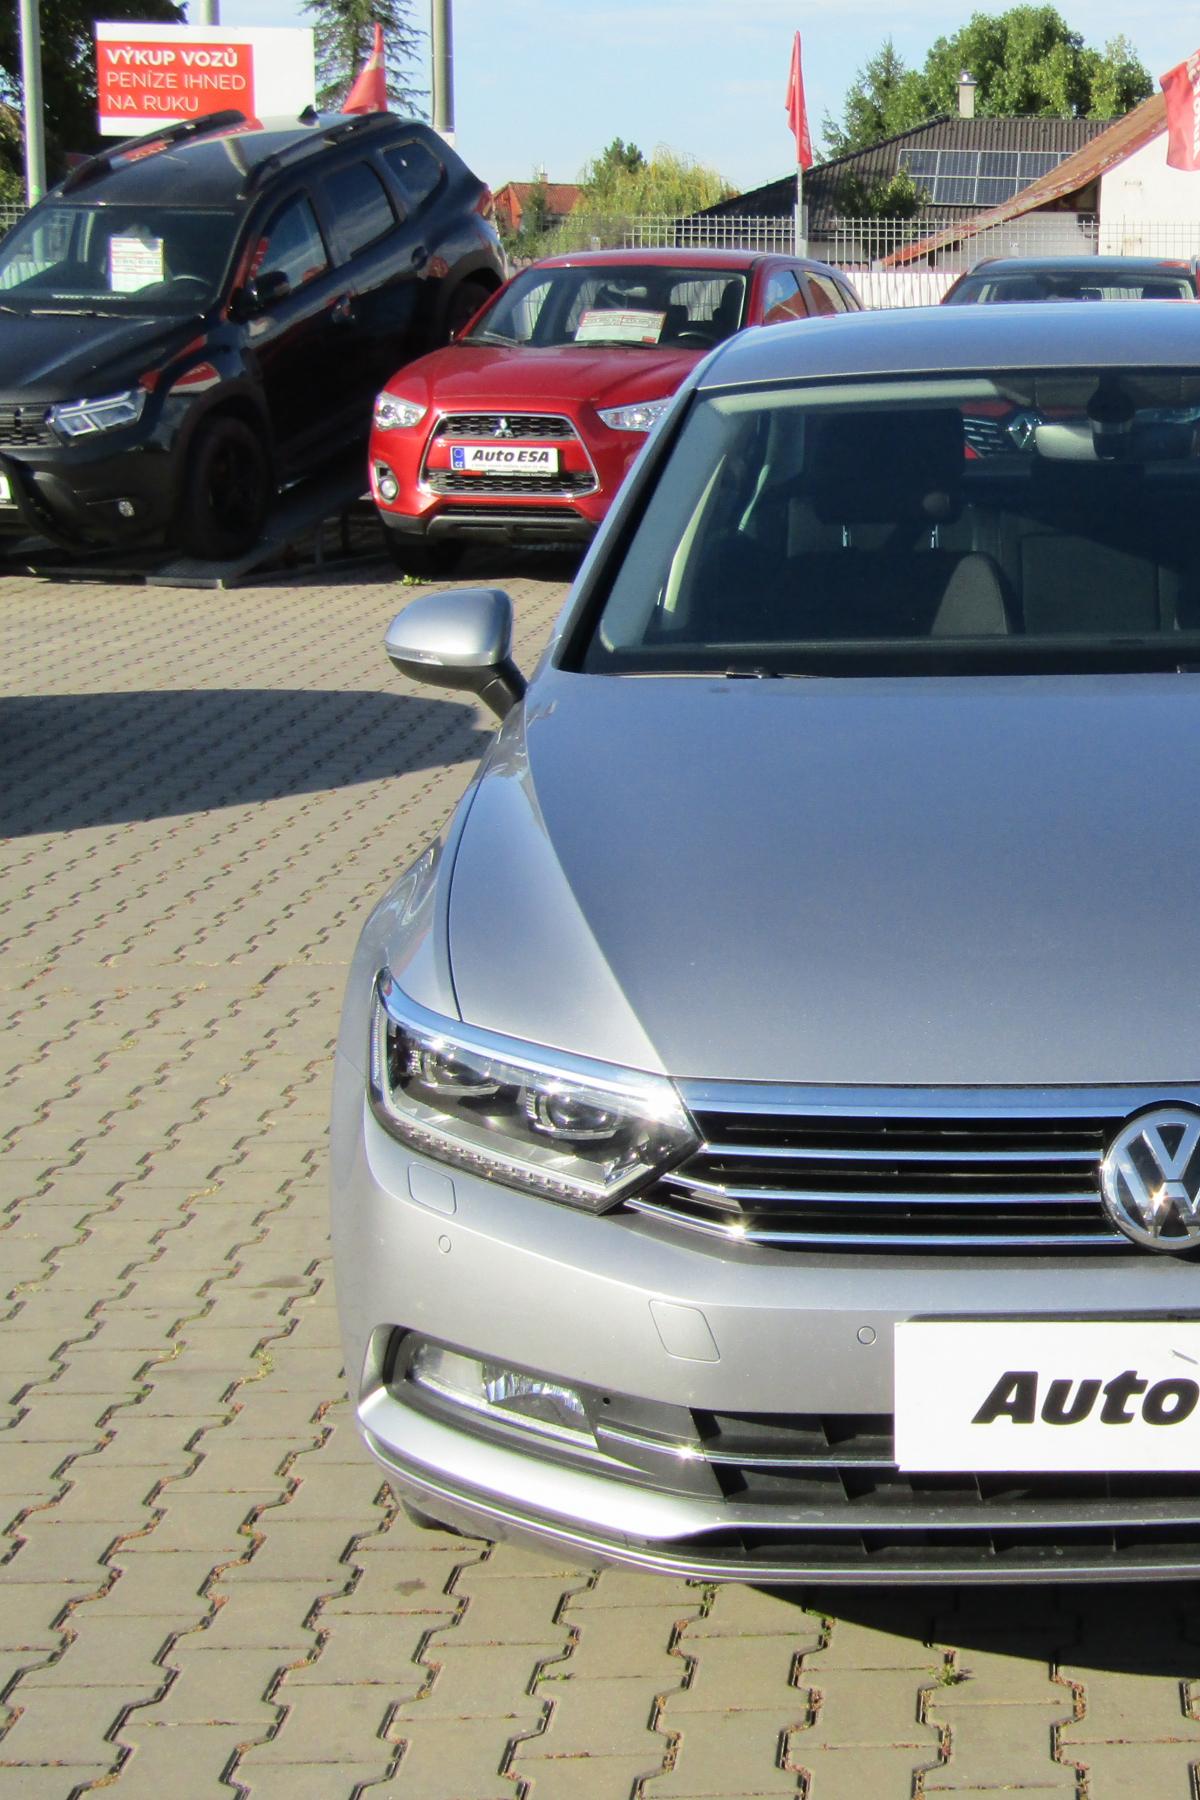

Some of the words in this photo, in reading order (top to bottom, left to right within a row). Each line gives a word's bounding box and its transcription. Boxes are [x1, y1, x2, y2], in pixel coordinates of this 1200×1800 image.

[107, 46, 176, 66] VÝKUP
[181, 49, 238, 67] VOZŮ
[106, 71, 178, 89] PENÍZE
[184, 74, 246, 90] IHNED
[107, 95, 137, 110] NA
[144, 96, 199, 112] RUKU
[472, 450, 514, 462] Auto
[517, 451, 549, 463] ESA
[971, 1370, 1200, 1426] Auto
